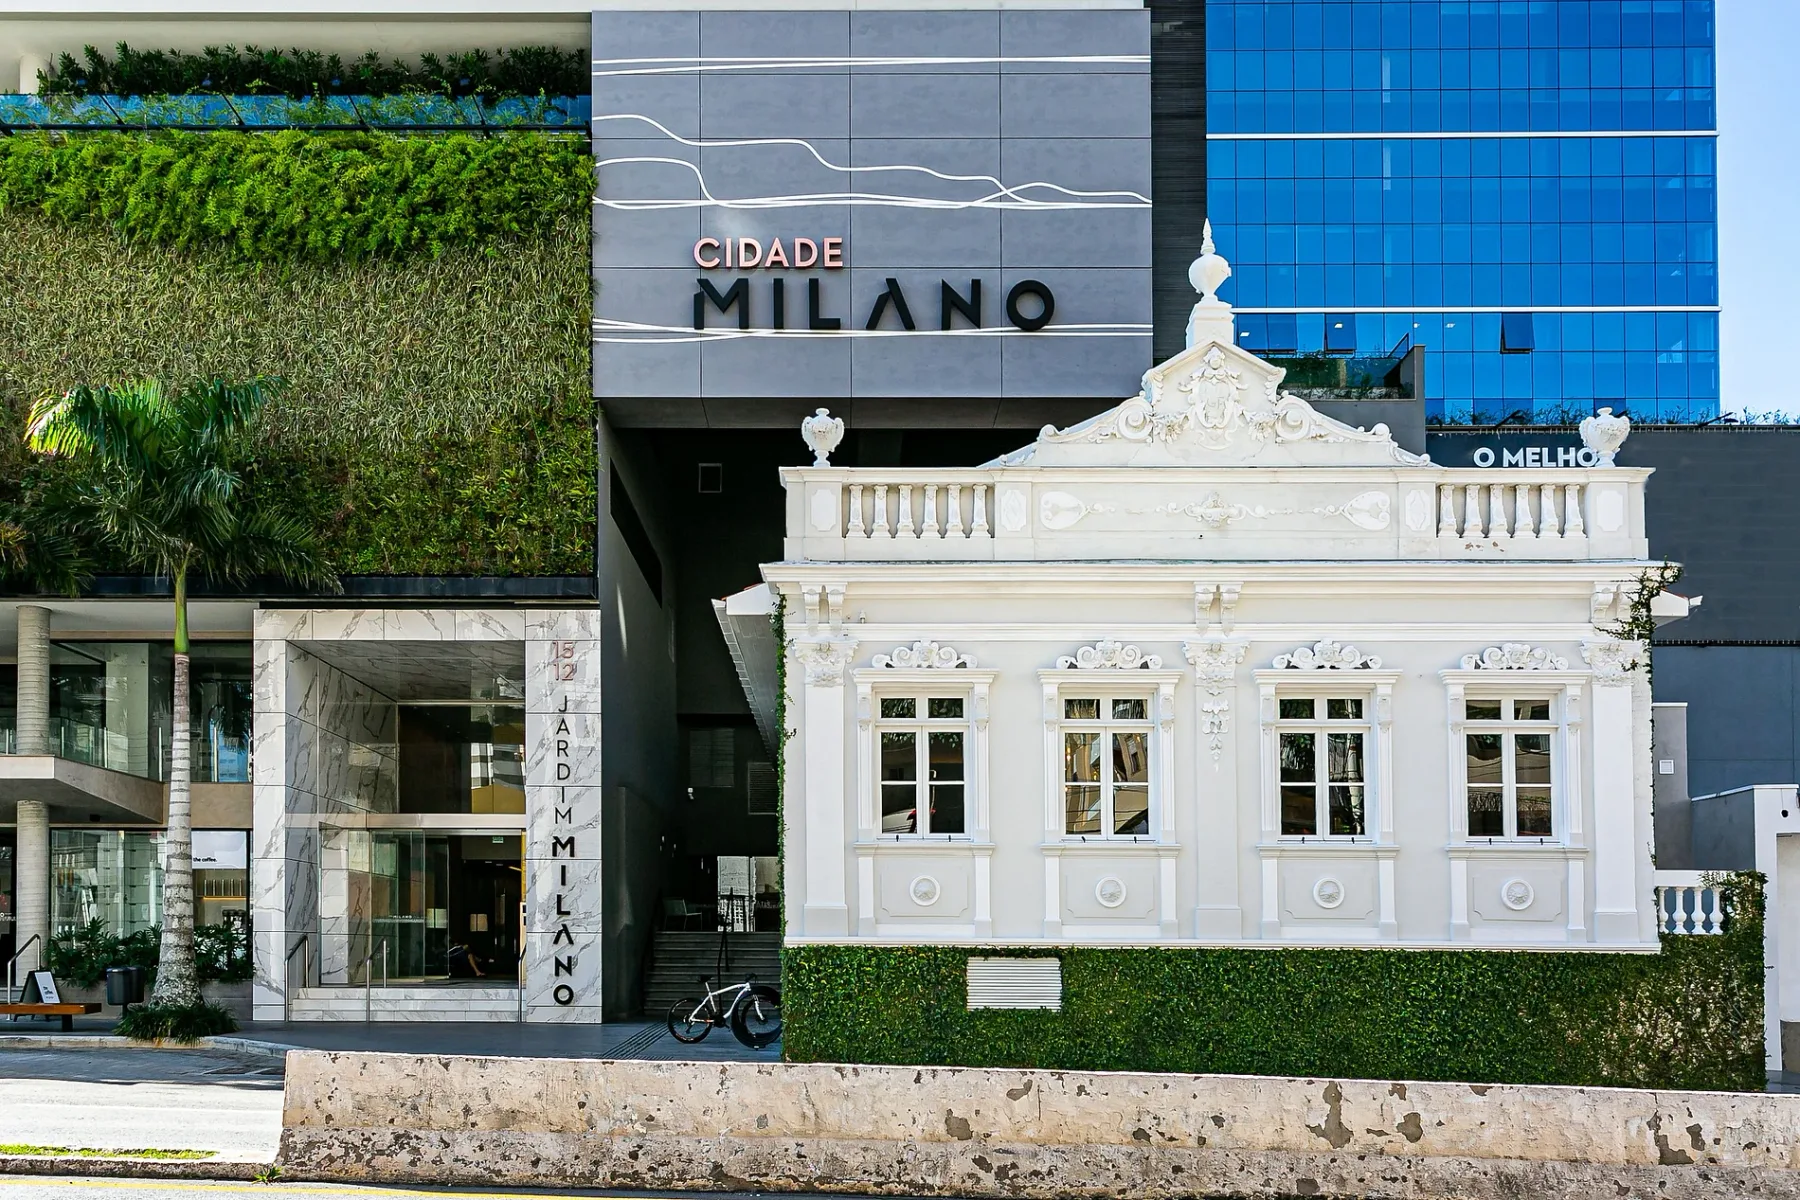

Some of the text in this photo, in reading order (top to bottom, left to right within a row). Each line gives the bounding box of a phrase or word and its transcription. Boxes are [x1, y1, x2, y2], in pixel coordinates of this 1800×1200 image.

[693, 237, 843, 268] CIDADE
[693, 278, 1055, 331] MILANO
[1473, 447, 1495, 468] O
[552, 640, 574, 659] 15
[552, 663, 574, 681] 12
[552, 695, 575, 1005] JARDIM MILANO
